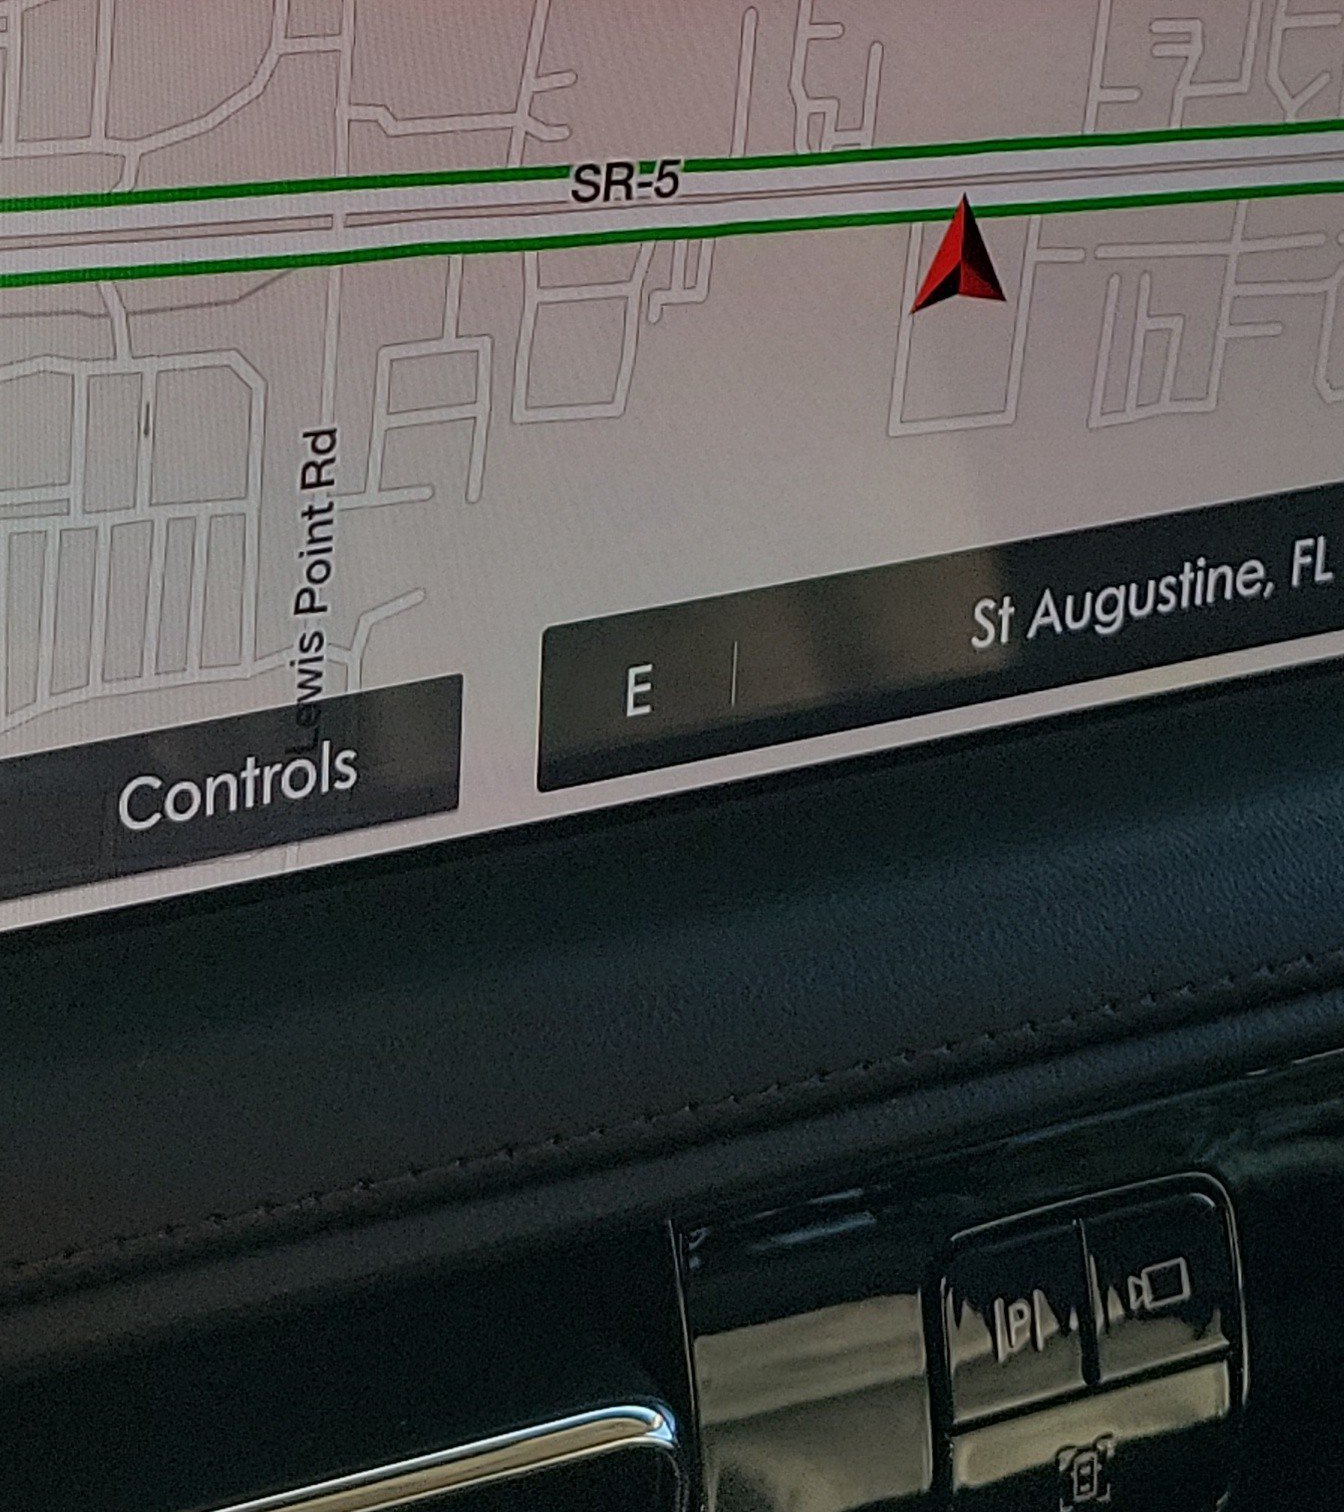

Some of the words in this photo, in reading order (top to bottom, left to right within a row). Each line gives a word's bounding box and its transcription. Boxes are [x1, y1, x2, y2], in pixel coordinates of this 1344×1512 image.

[570, 158, 682, 205] SR-5
[299, 427, 338, 491] Rd
[293, 501, 335, 616] Point
[971, 598, 1015, 649] St
[1026, 555, 1274, 635] Augustine,
[1291, 535, 1334, 588] FL
[625, 664, 653, 716] E
[118, 740, 359, 832] Controls
